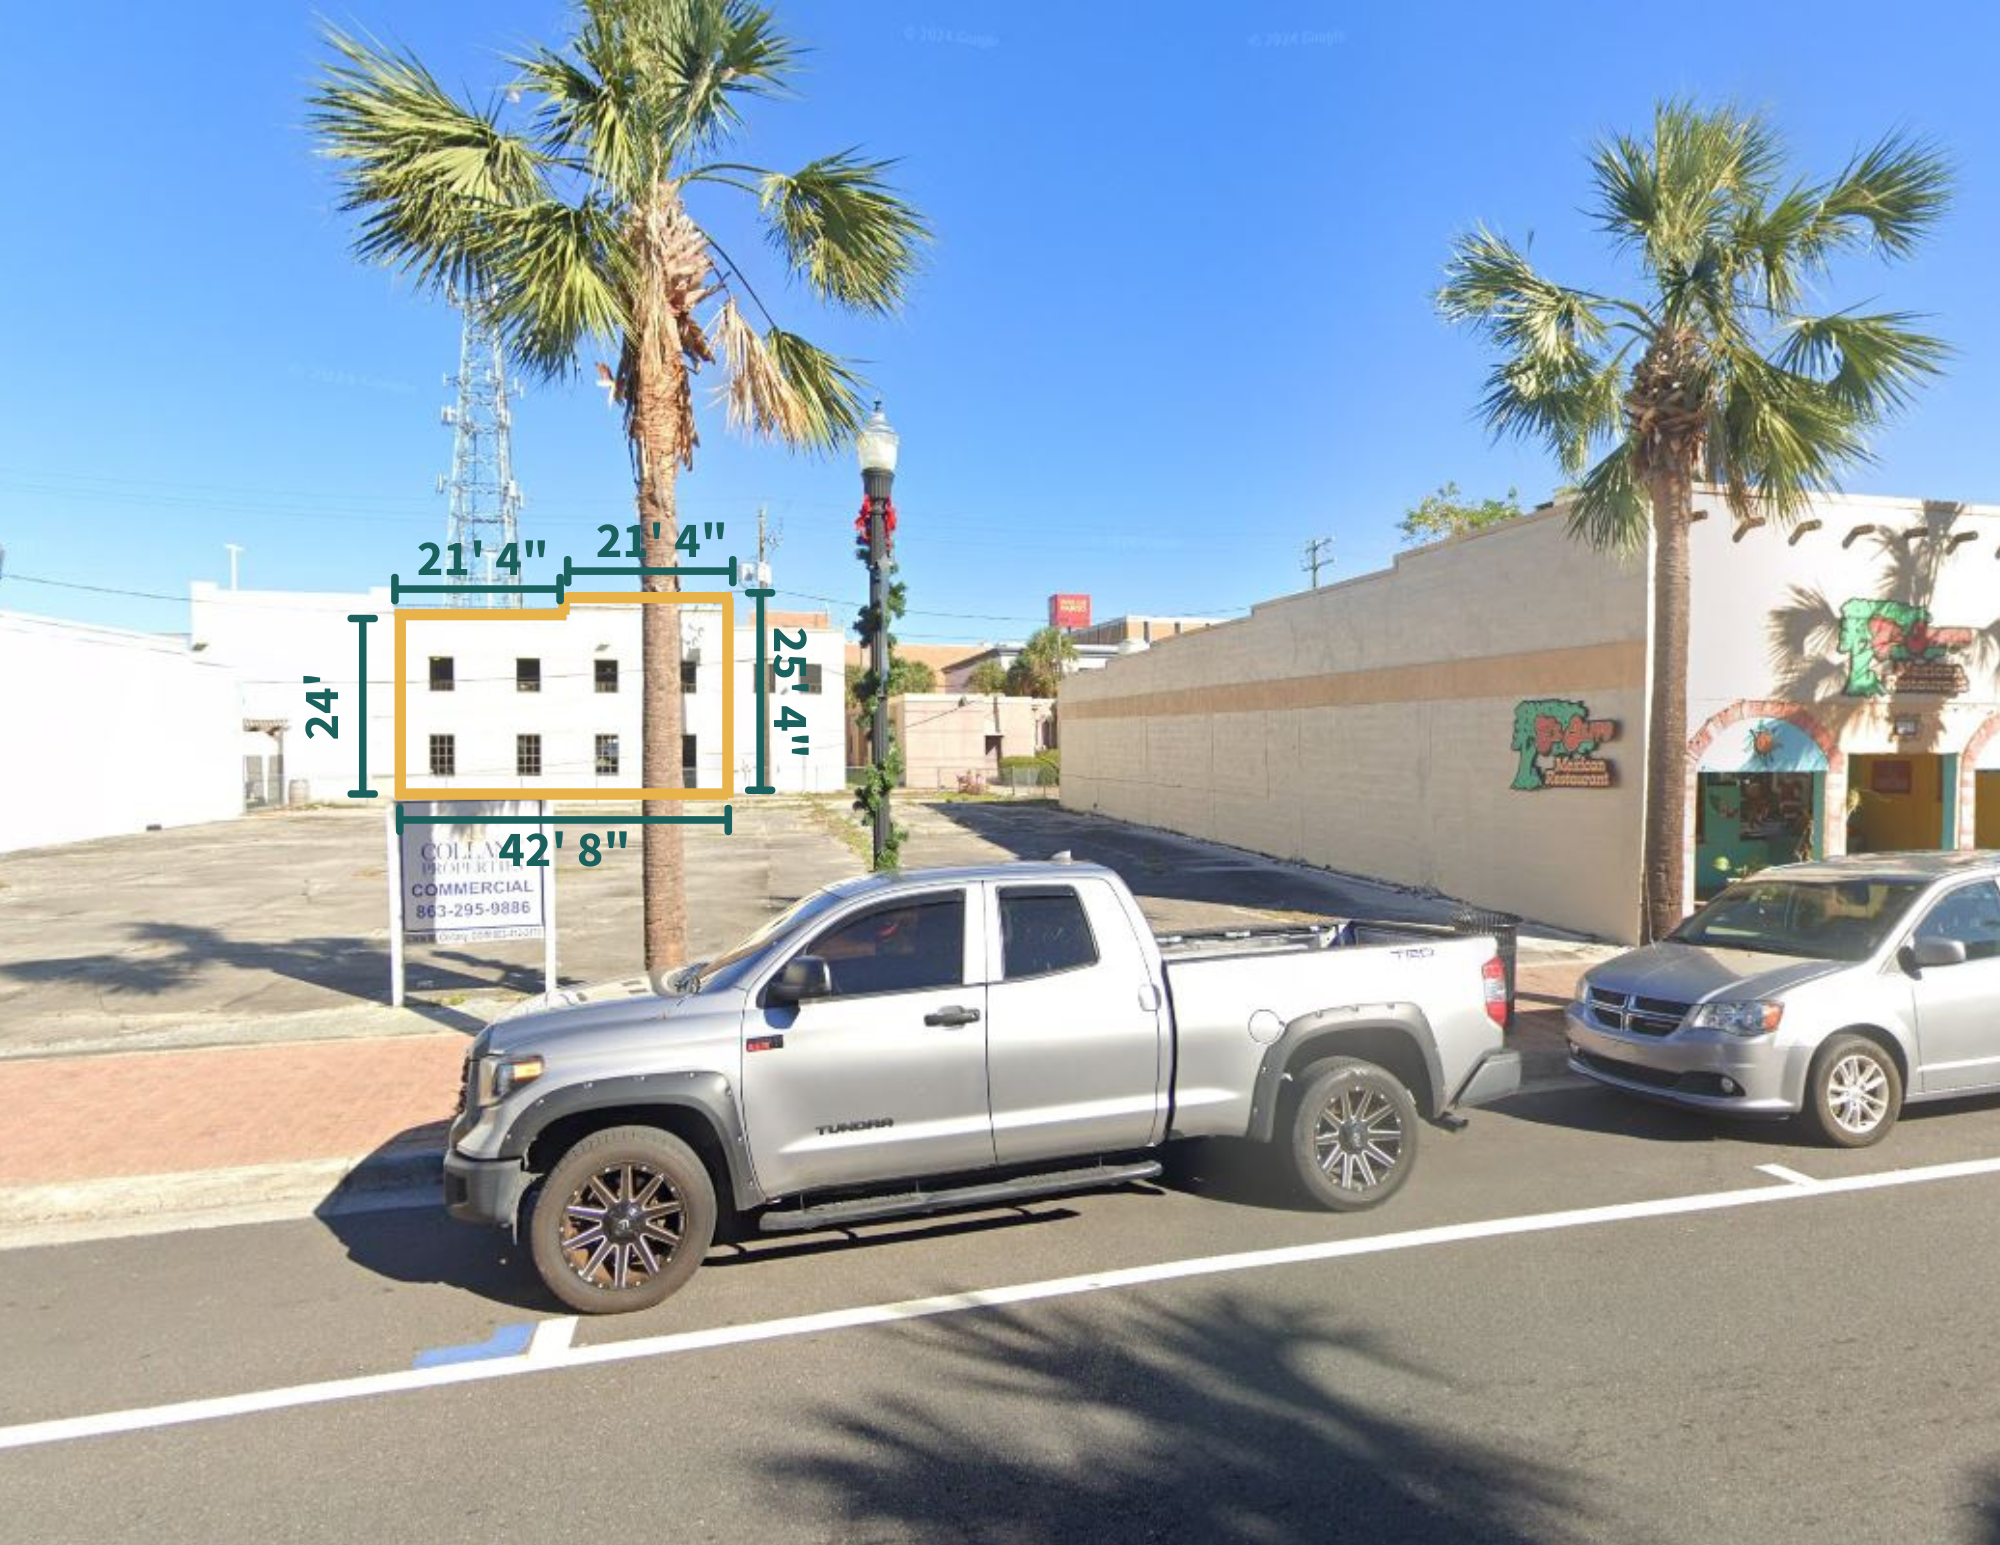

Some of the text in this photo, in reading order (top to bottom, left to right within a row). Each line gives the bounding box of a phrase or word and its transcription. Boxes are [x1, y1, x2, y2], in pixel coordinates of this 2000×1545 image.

[411, 879, 535, 897] COMMERCIAL
[416, 900, 532, 919] 863-295-9886
[815, 1117, 895, 1136] TUNDRA
